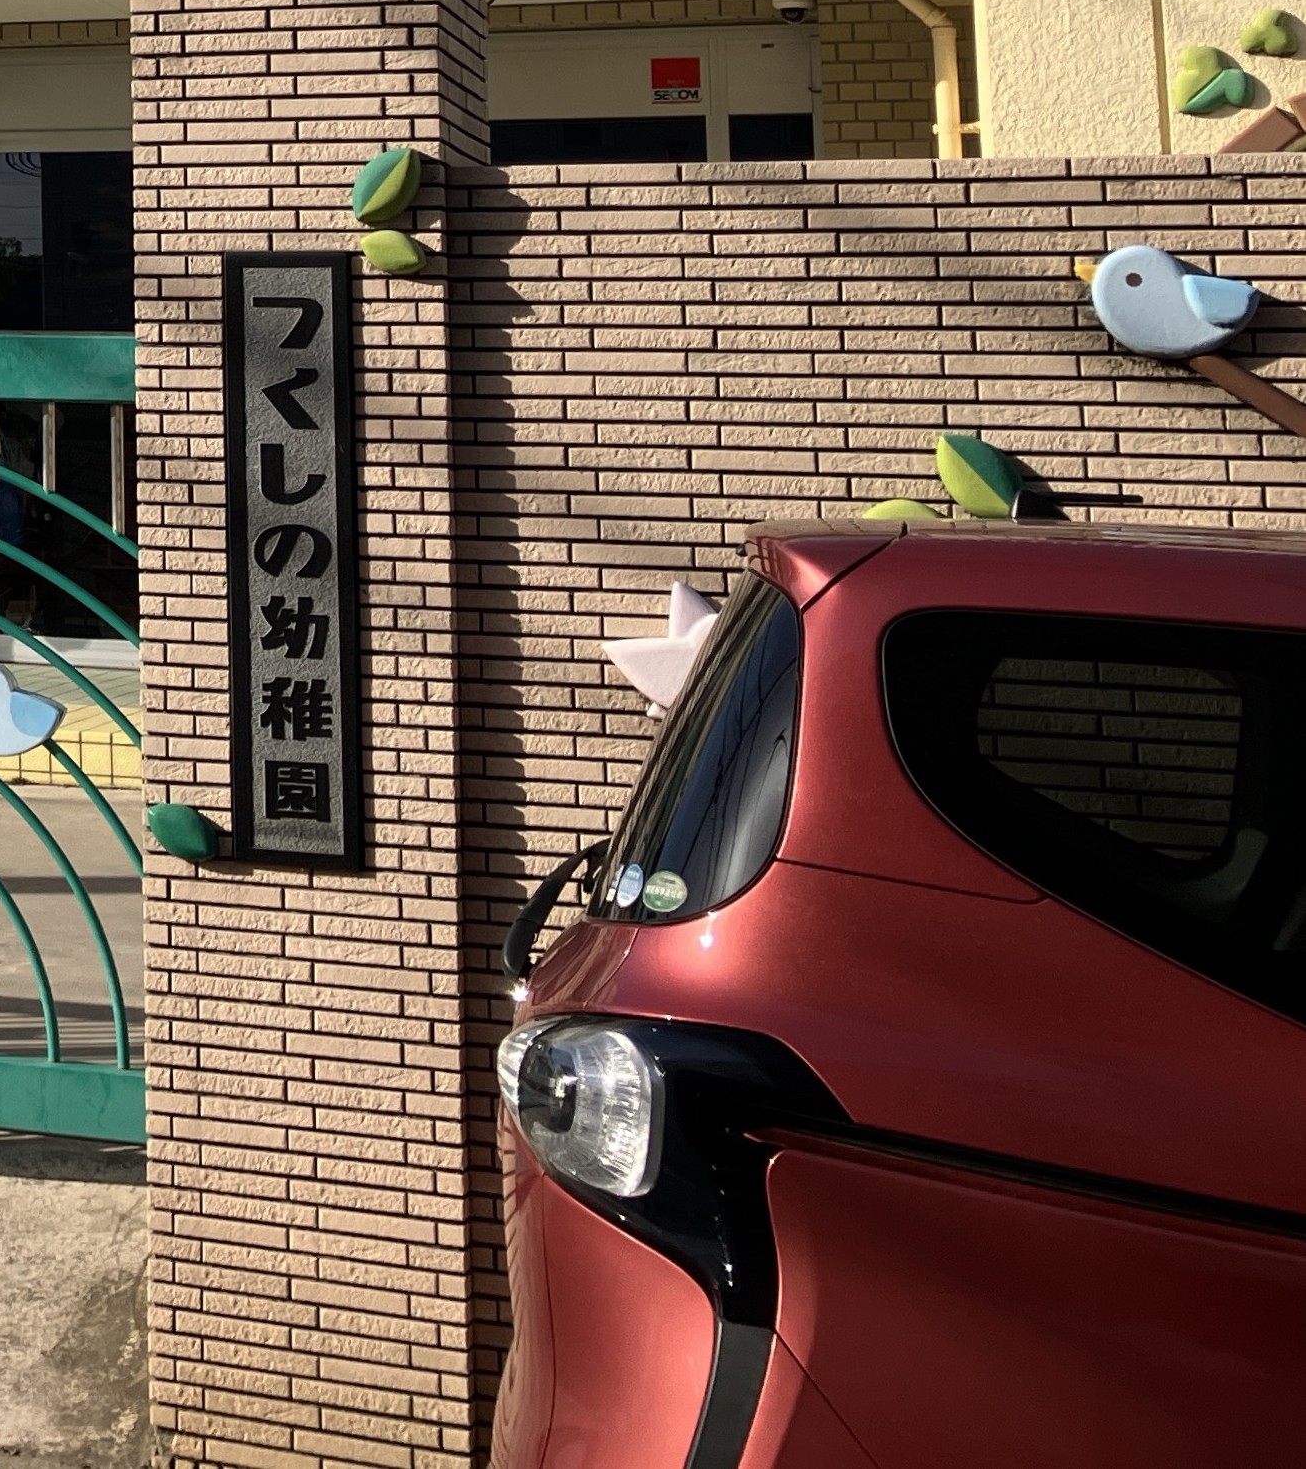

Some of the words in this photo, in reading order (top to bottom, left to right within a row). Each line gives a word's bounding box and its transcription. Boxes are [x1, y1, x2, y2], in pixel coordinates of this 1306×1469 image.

[653, 89, 700, 101] SECOM
[252, 295, 334, 823] つくしの幼稚園
